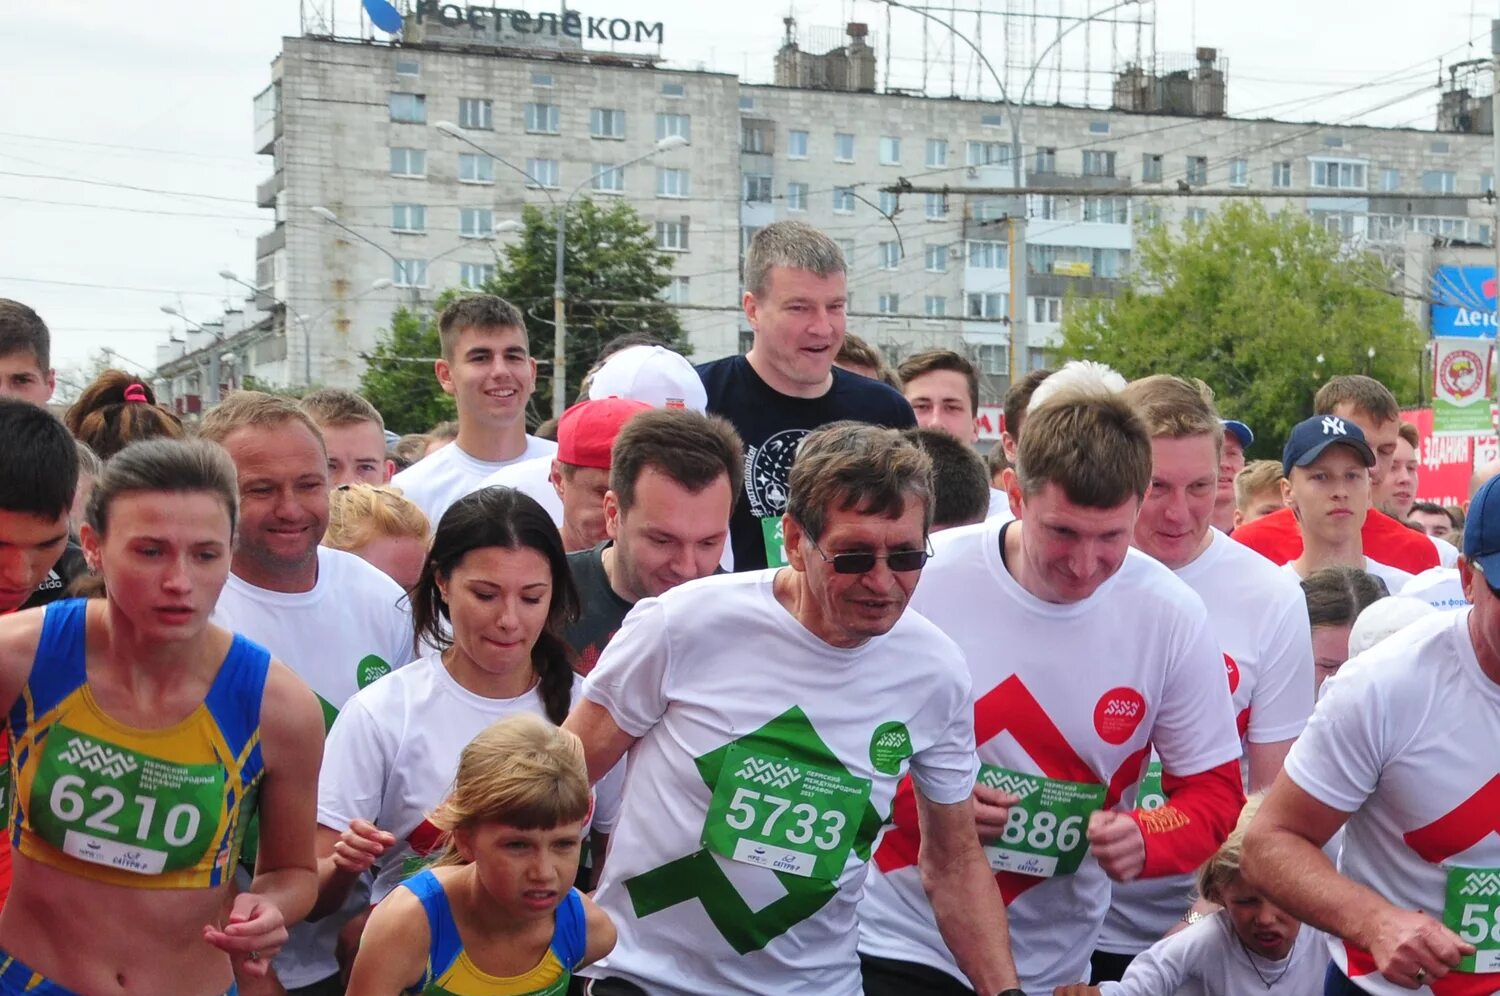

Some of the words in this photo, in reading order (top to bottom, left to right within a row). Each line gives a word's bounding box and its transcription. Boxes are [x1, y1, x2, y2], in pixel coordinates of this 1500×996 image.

[50, 775, 200, 846] 6210
[725, 787, 846, 850] 5733
[1002, 806, 1083, 852] 886
